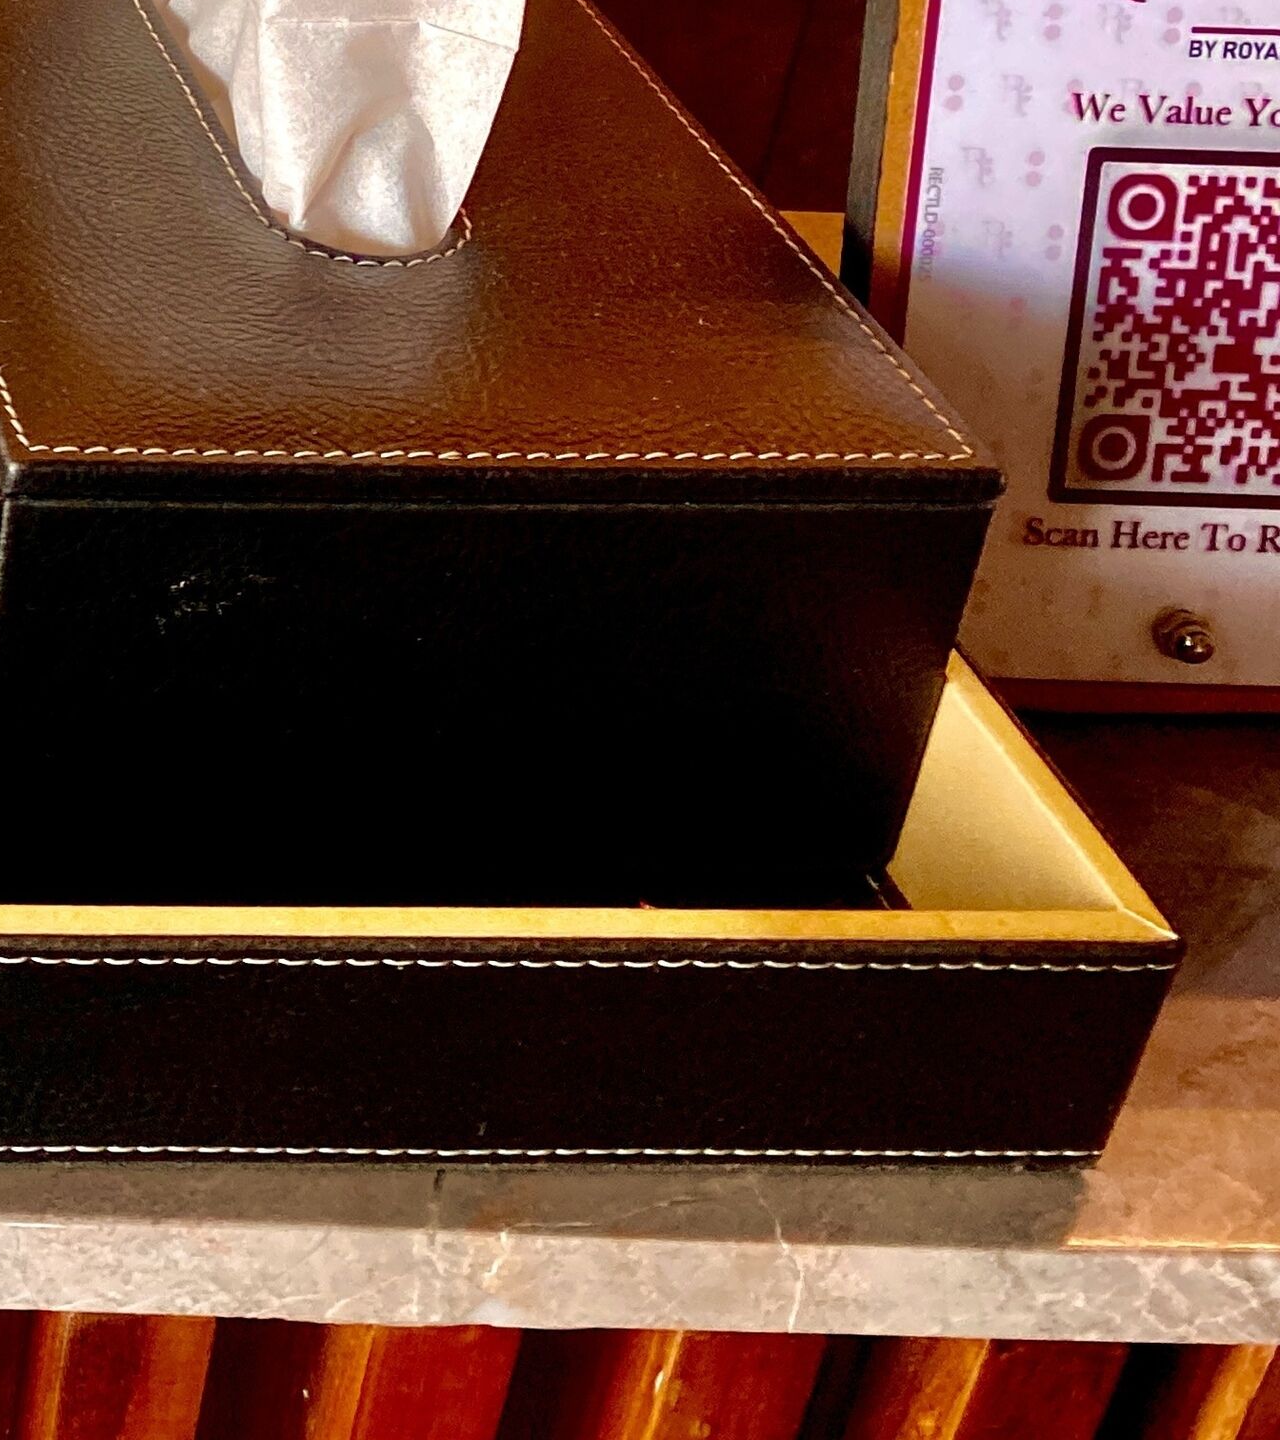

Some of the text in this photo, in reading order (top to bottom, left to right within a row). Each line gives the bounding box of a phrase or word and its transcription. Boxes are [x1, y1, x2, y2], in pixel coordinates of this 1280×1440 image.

[1189, 40, 1217, 58] BY
[1072, 94, 1125, 123] We
[1140, 94, 1231, 126] Value
[1023, 518, 1099, 548] Scan
[1111, 521, 1190, 550] Here
[1201, 524, 1246, 552] To
